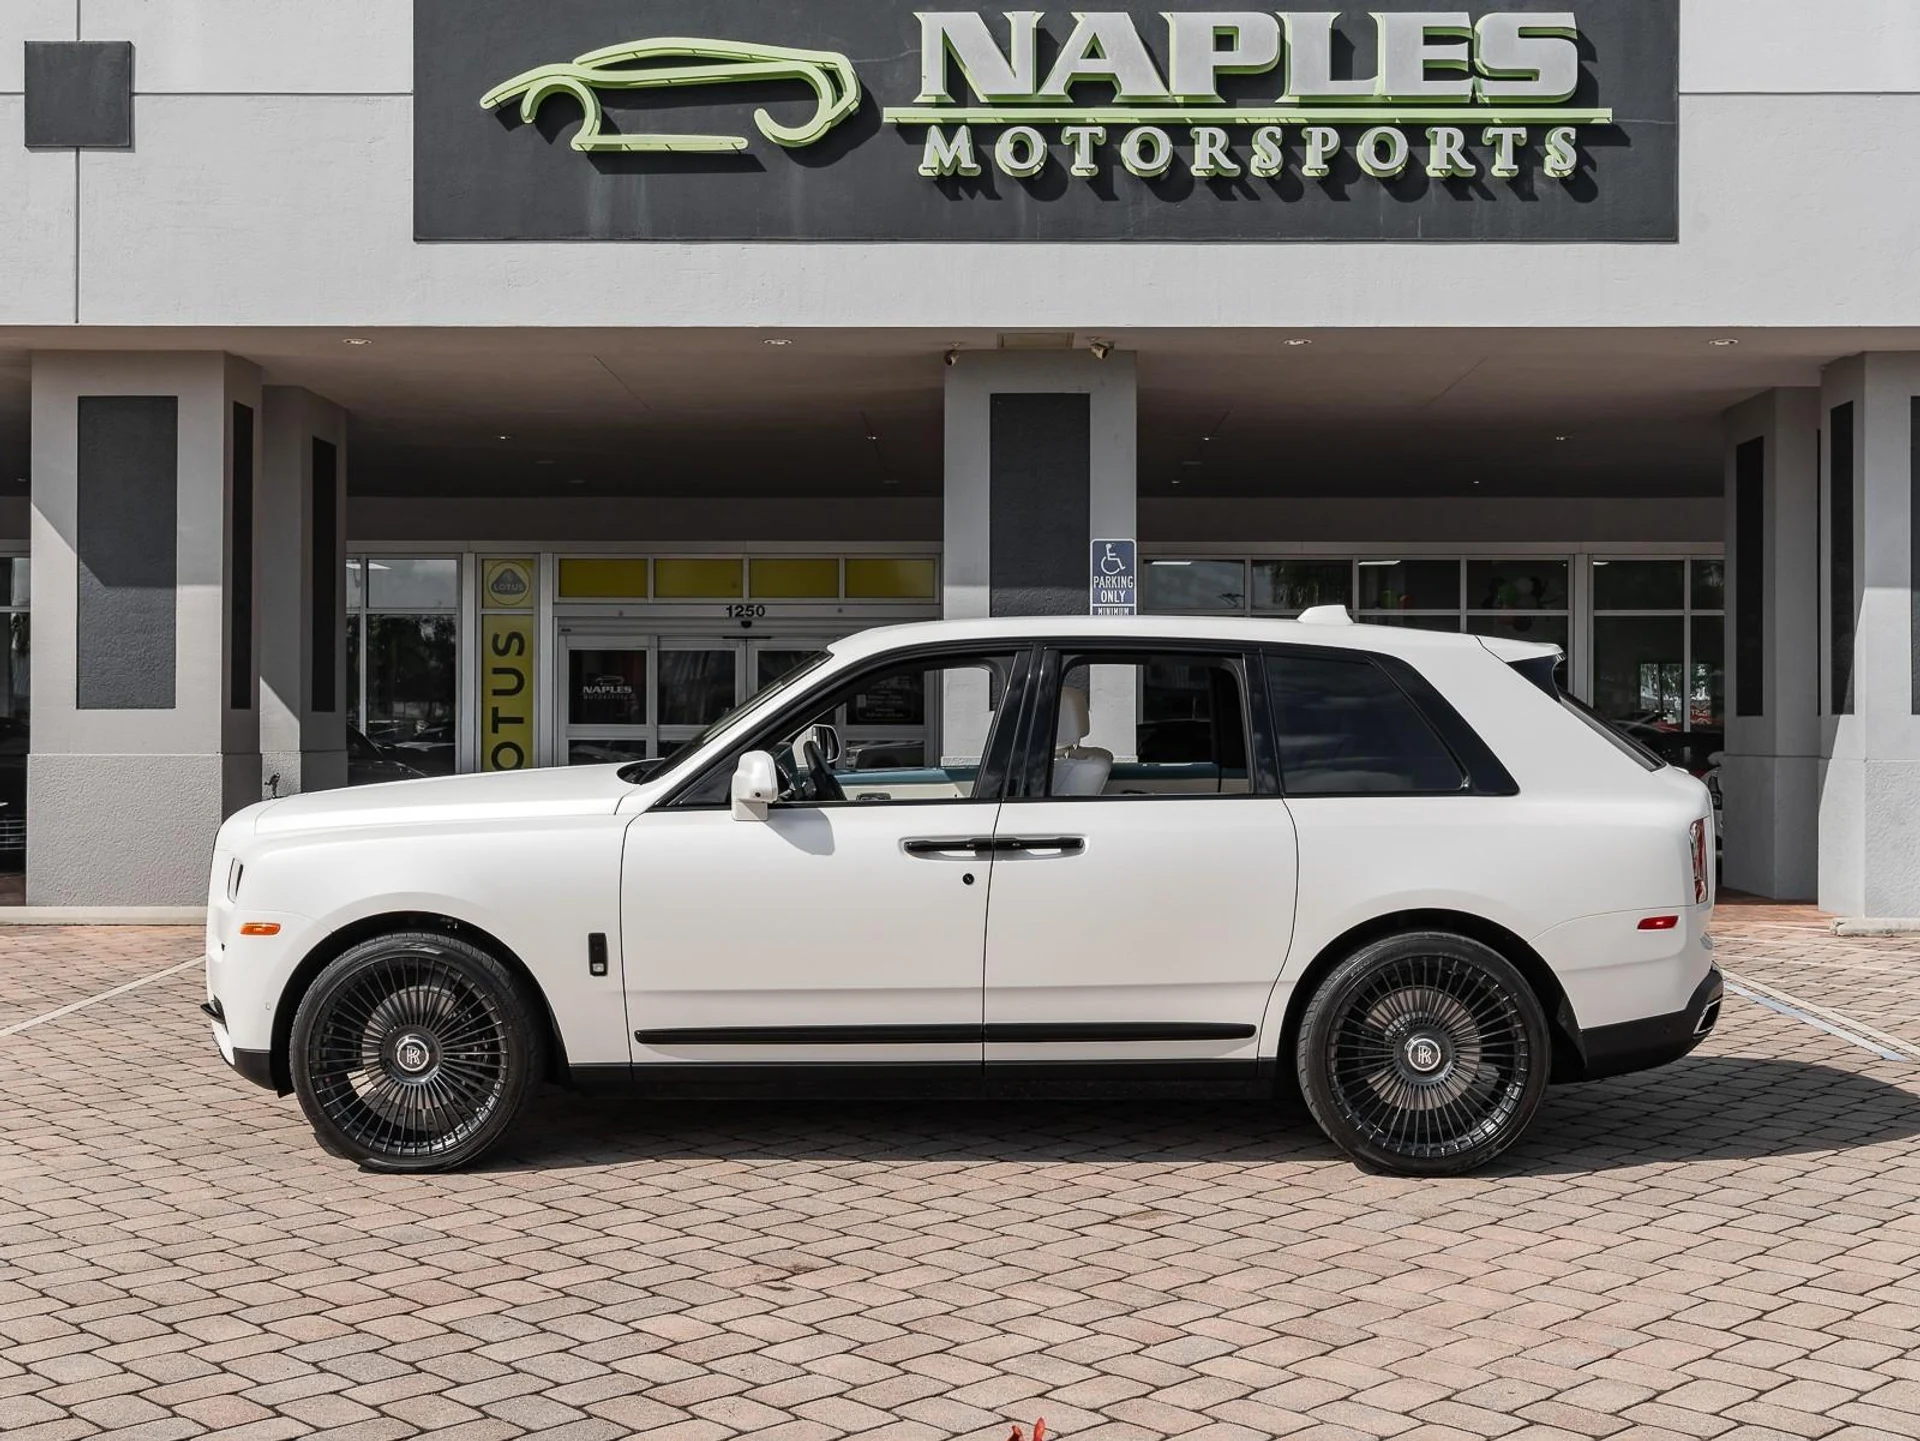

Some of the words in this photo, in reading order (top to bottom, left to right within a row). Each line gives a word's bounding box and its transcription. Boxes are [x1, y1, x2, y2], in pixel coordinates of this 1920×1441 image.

[913, 11, 1578, 103] NAPLES
[918, 125, 1577, 177] MOTORSPORTS
[493, 583, 525, 592] LOTUS
[1093, 575, 1134, 589] PARKING
[1100, 590, 1126, 603] ONLY
[726, 604, 766, 618] 1250
[583, 686, 632, 694] NAPLES
[491, 631, 525, 771] OTUS
